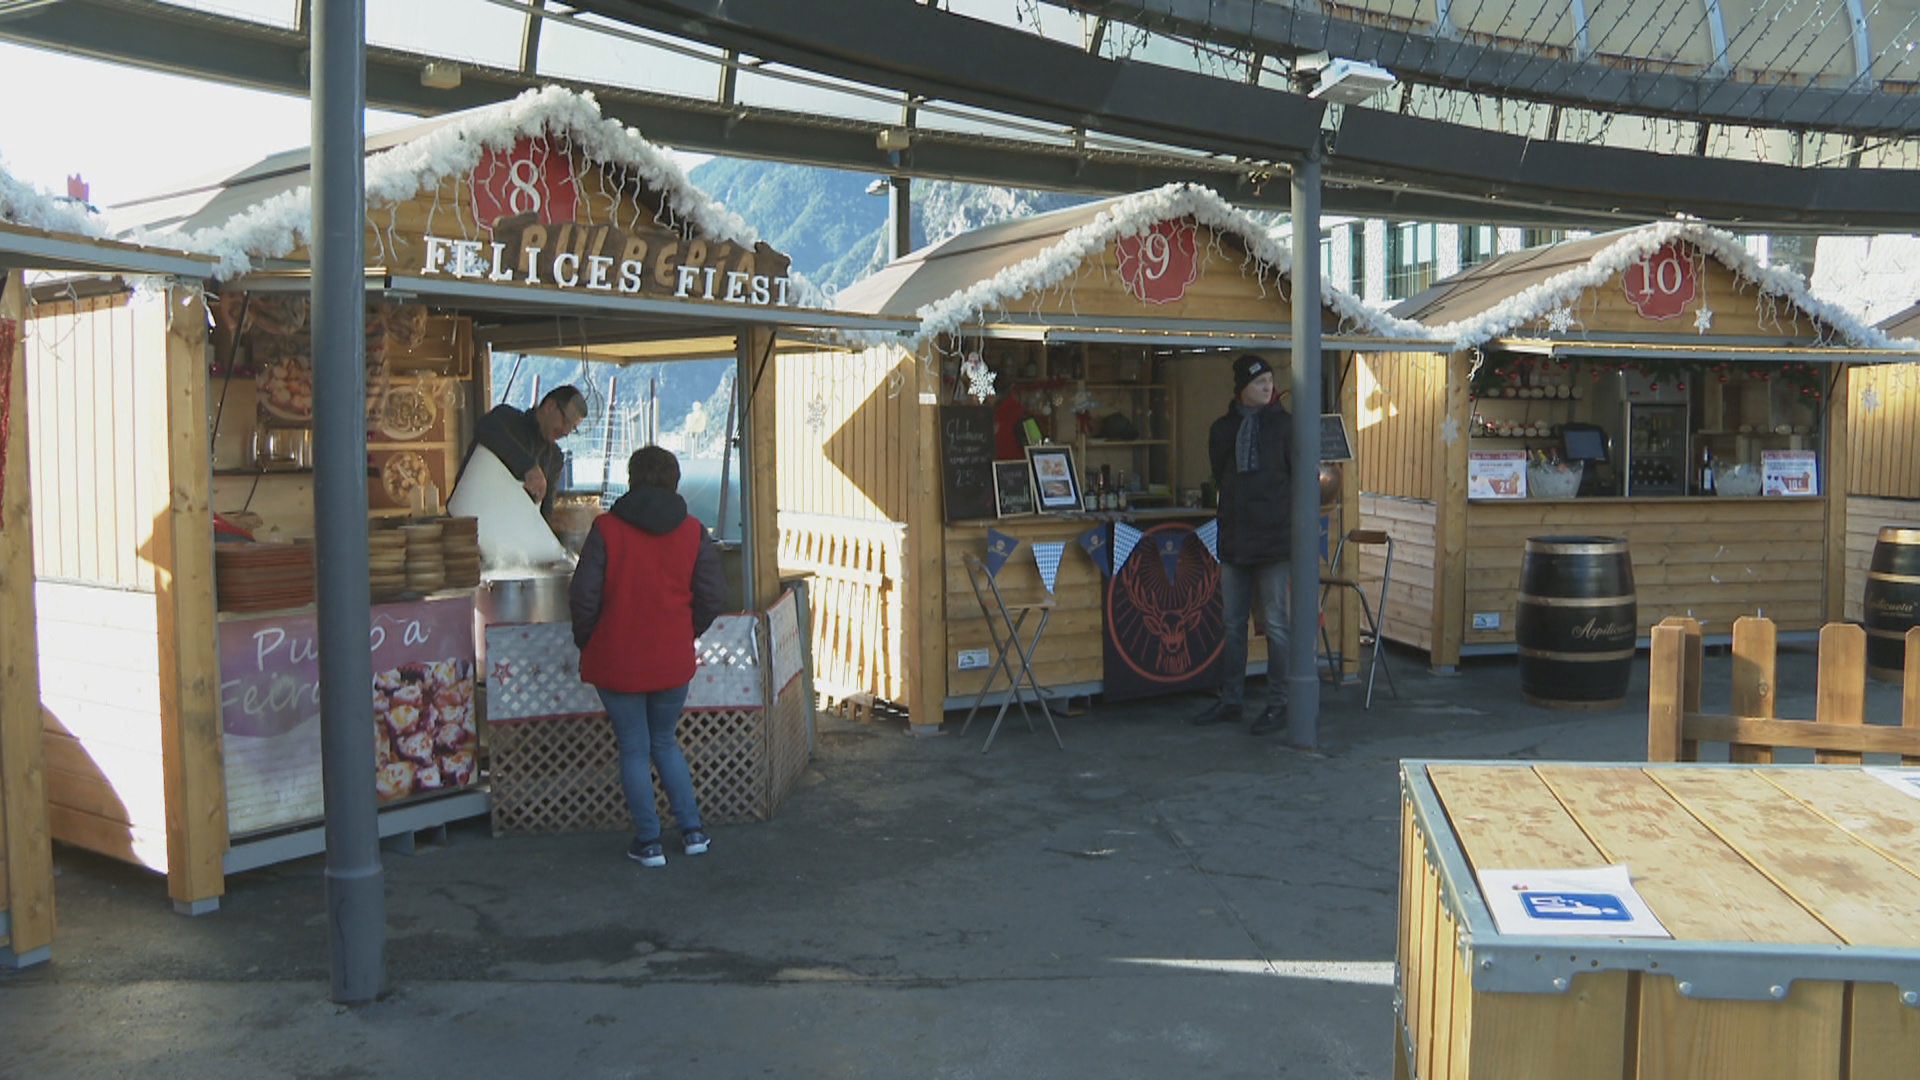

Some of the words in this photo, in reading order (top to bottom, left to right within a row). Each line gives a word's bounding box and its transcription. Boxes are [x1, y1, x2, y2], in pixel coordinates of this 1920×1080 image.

[510, 160, 541, 215] 8
[421, 235, 642, 293] FELICES
[674, 264, 840, 312] FIESTAS
[1145, 233, 1170, 280] 9
[1639, 258, 1682, 295] 10
[253, 626, 386, 672] Puo
